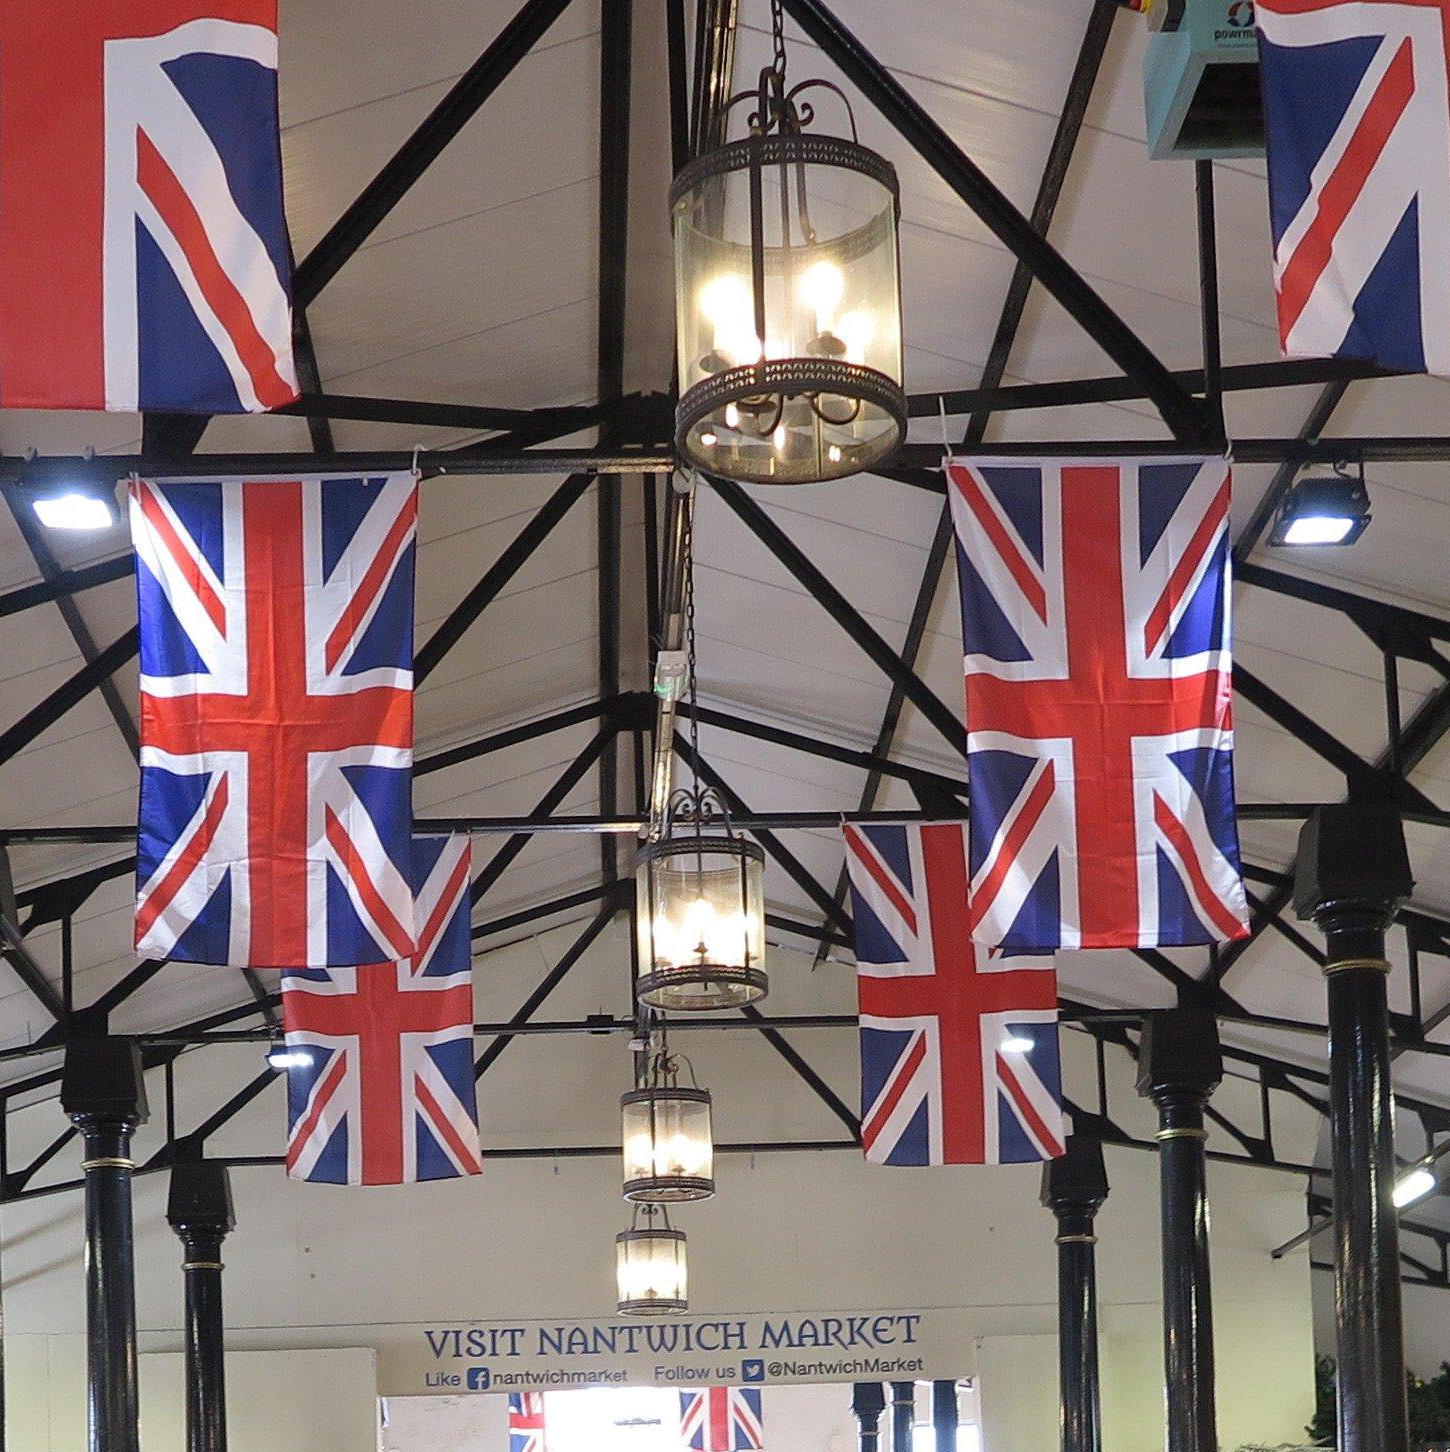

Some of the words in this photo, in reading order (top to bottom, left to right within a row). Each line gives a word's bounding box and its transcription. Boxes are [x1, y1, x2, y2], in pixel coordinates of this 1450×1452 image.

[424, 1328, 525, 1359] VISIT
[537, 1321, 748, 1355] NANTWICH
[758, 1315, 921, 1350] MARKET
[425, 1371, 461, 1387] Like
[493, 1367, 628, 1386] nantwichmarket
[654, 1363, 710, 1380] Follow
[716, 1366, 736, 1379] us
[767, 1356, 924, 1376] @NantwichMarket
